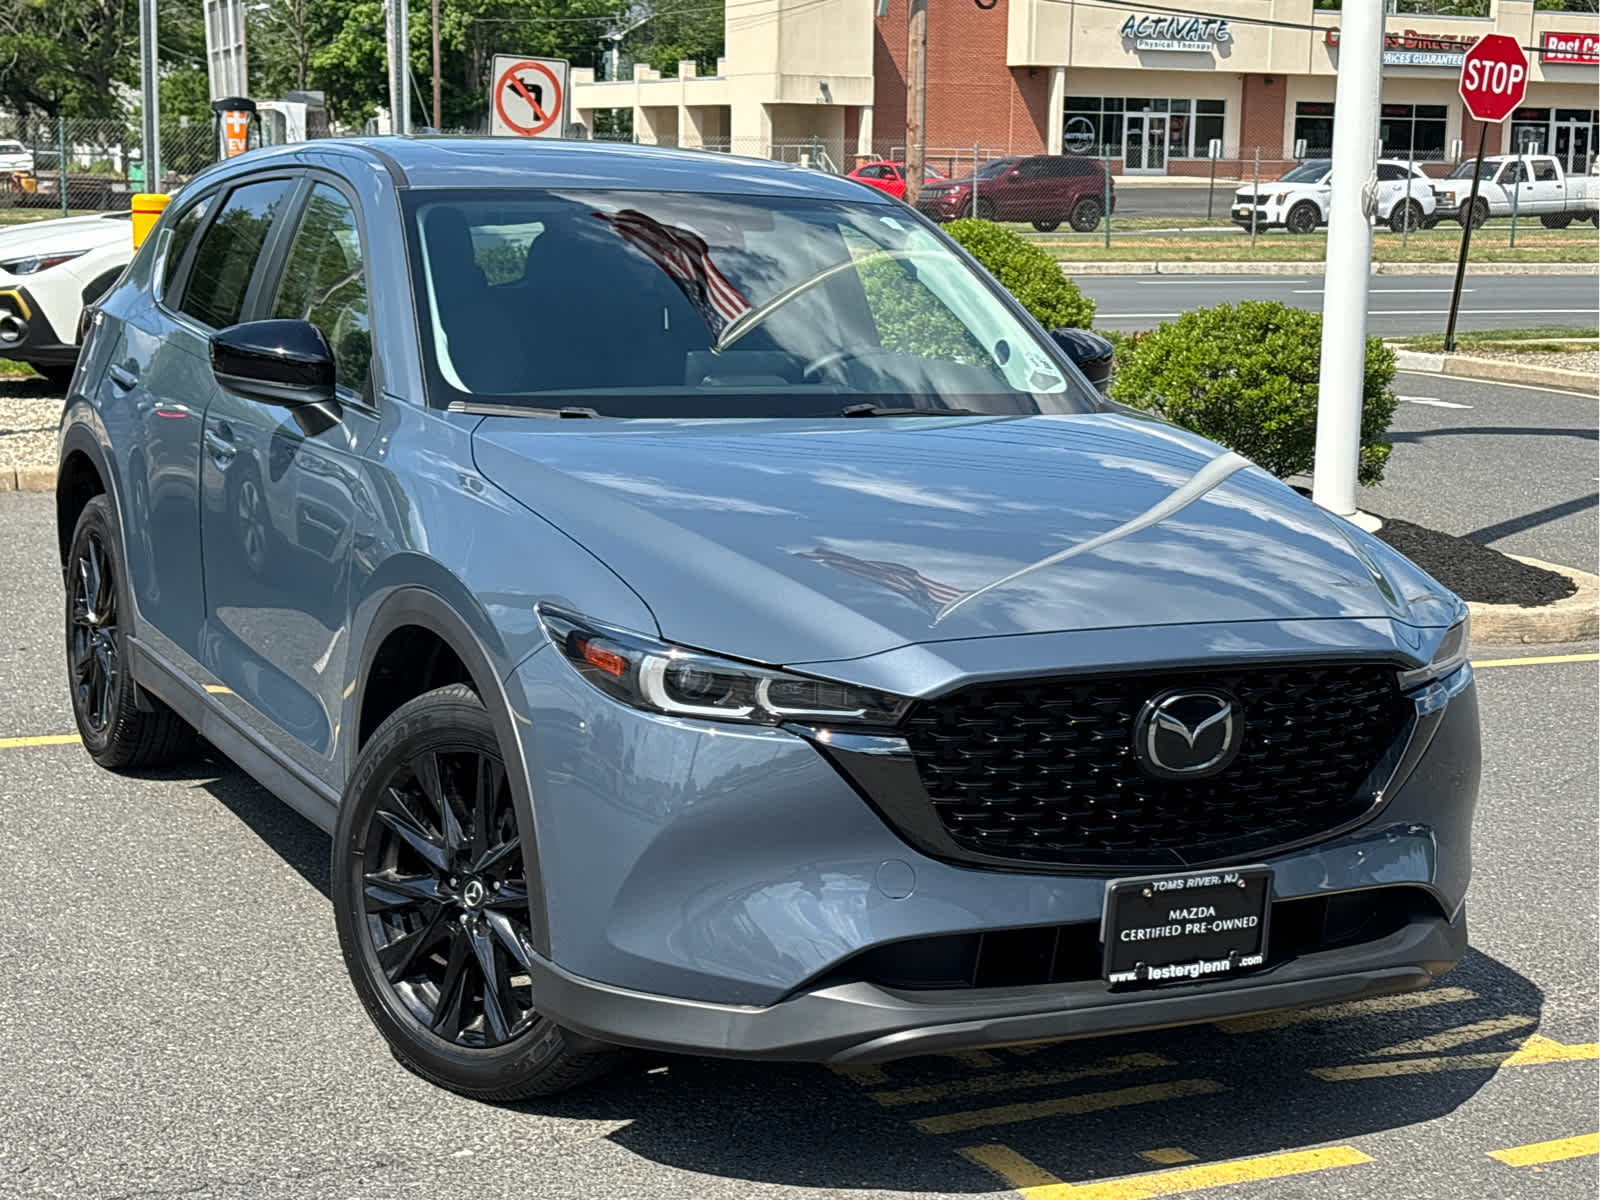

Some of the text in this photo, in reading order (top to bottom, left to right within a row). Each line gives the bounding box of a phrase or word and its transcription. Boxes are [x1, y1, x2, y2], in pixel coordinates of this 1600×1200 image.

[1120, 14, 1230, 41] ACTIVATE
[1139, 40, 1211, 51] Physical Therapy
[1547, 36, 1580, 59] Best
[1465, 58, 1524, 95] STOP
[229, 138, 246, 150] EV
[1152, 879, 1185, 892] TOMS
[1224, 872, 1239, 883] NJ
[1168, 905, 1216, 920] MAZDA
[1120, 916, 1258, 942] CERTIFIED PRE-OWNED
[1109, 954, 1263, 983] www. lesterglenn .com
